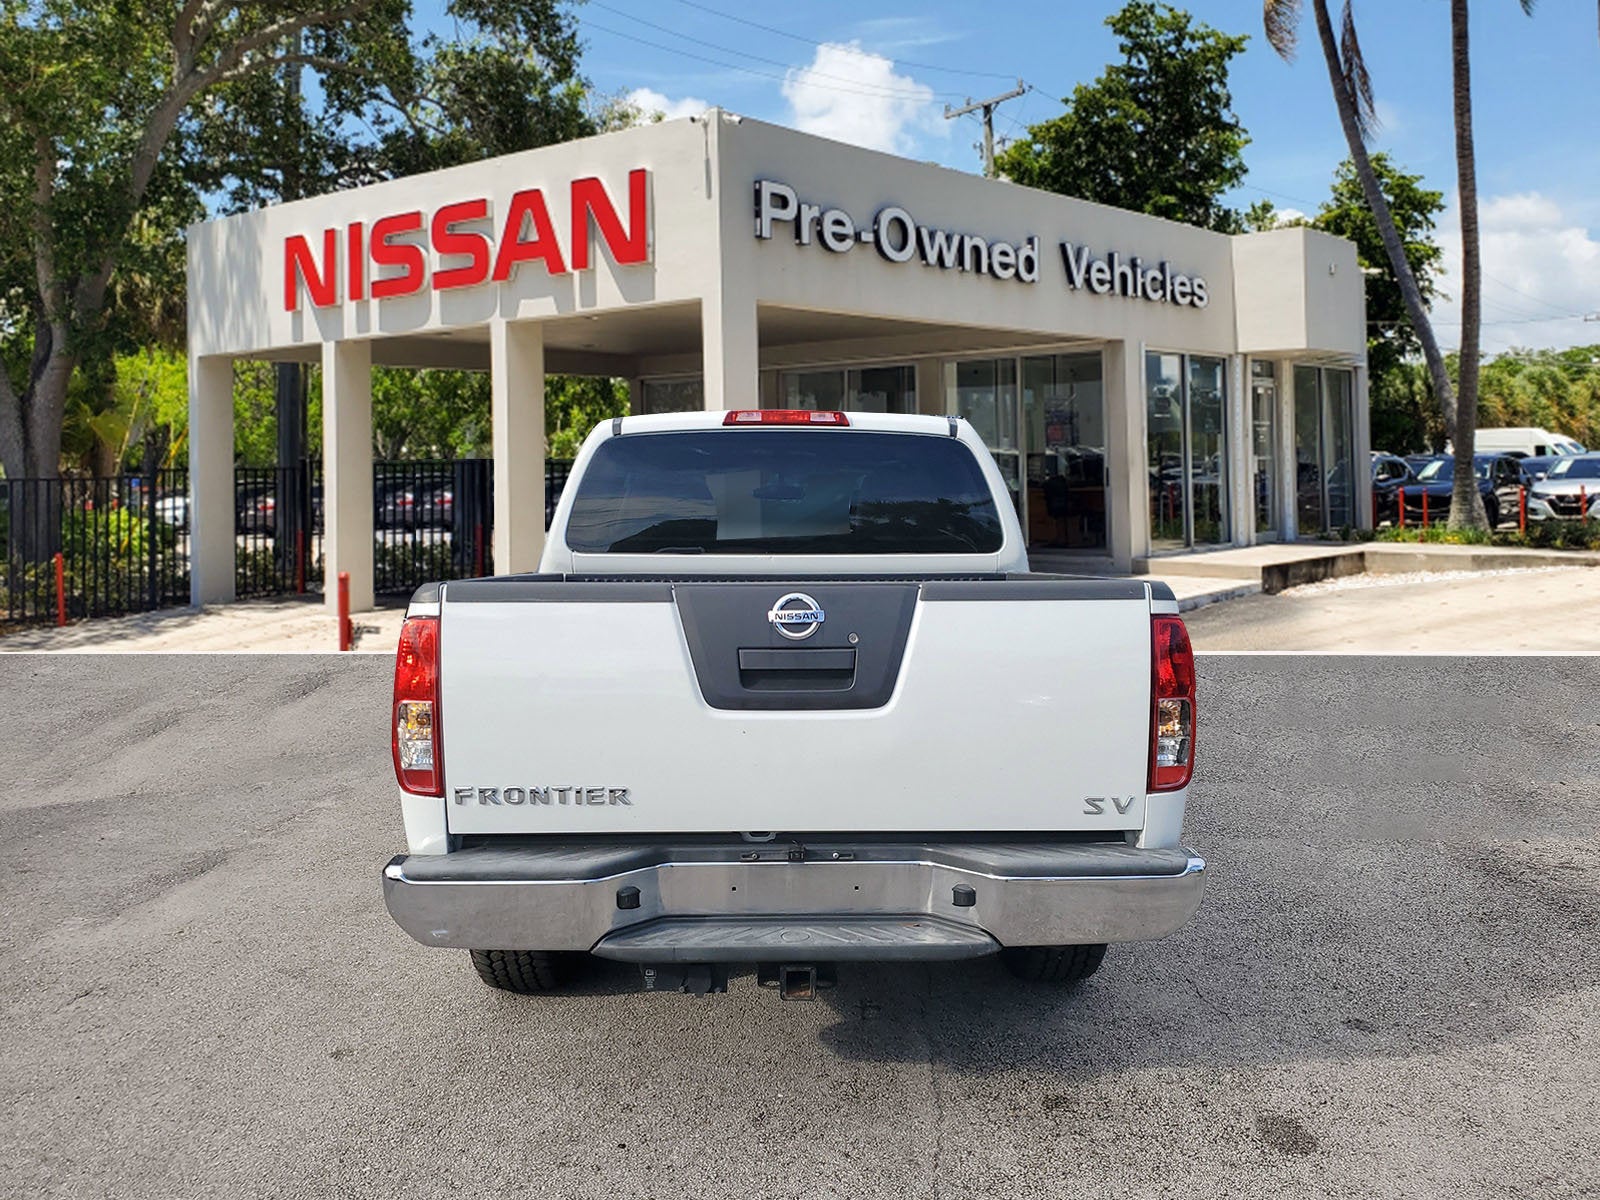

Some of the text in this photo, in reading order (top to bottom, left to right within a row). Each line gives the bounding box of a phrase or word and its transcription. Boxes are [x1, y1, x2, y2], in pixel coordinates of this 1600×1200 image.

[285, 168, 648, 312] NISSAN
[753, 179, 1208, 309] Pre-Owned Vehicles
[774, 612, 819, 621] NISSAN
[454, 786, 632, 806] FRONTIER
[1083, 796, 1135, 815] SV
